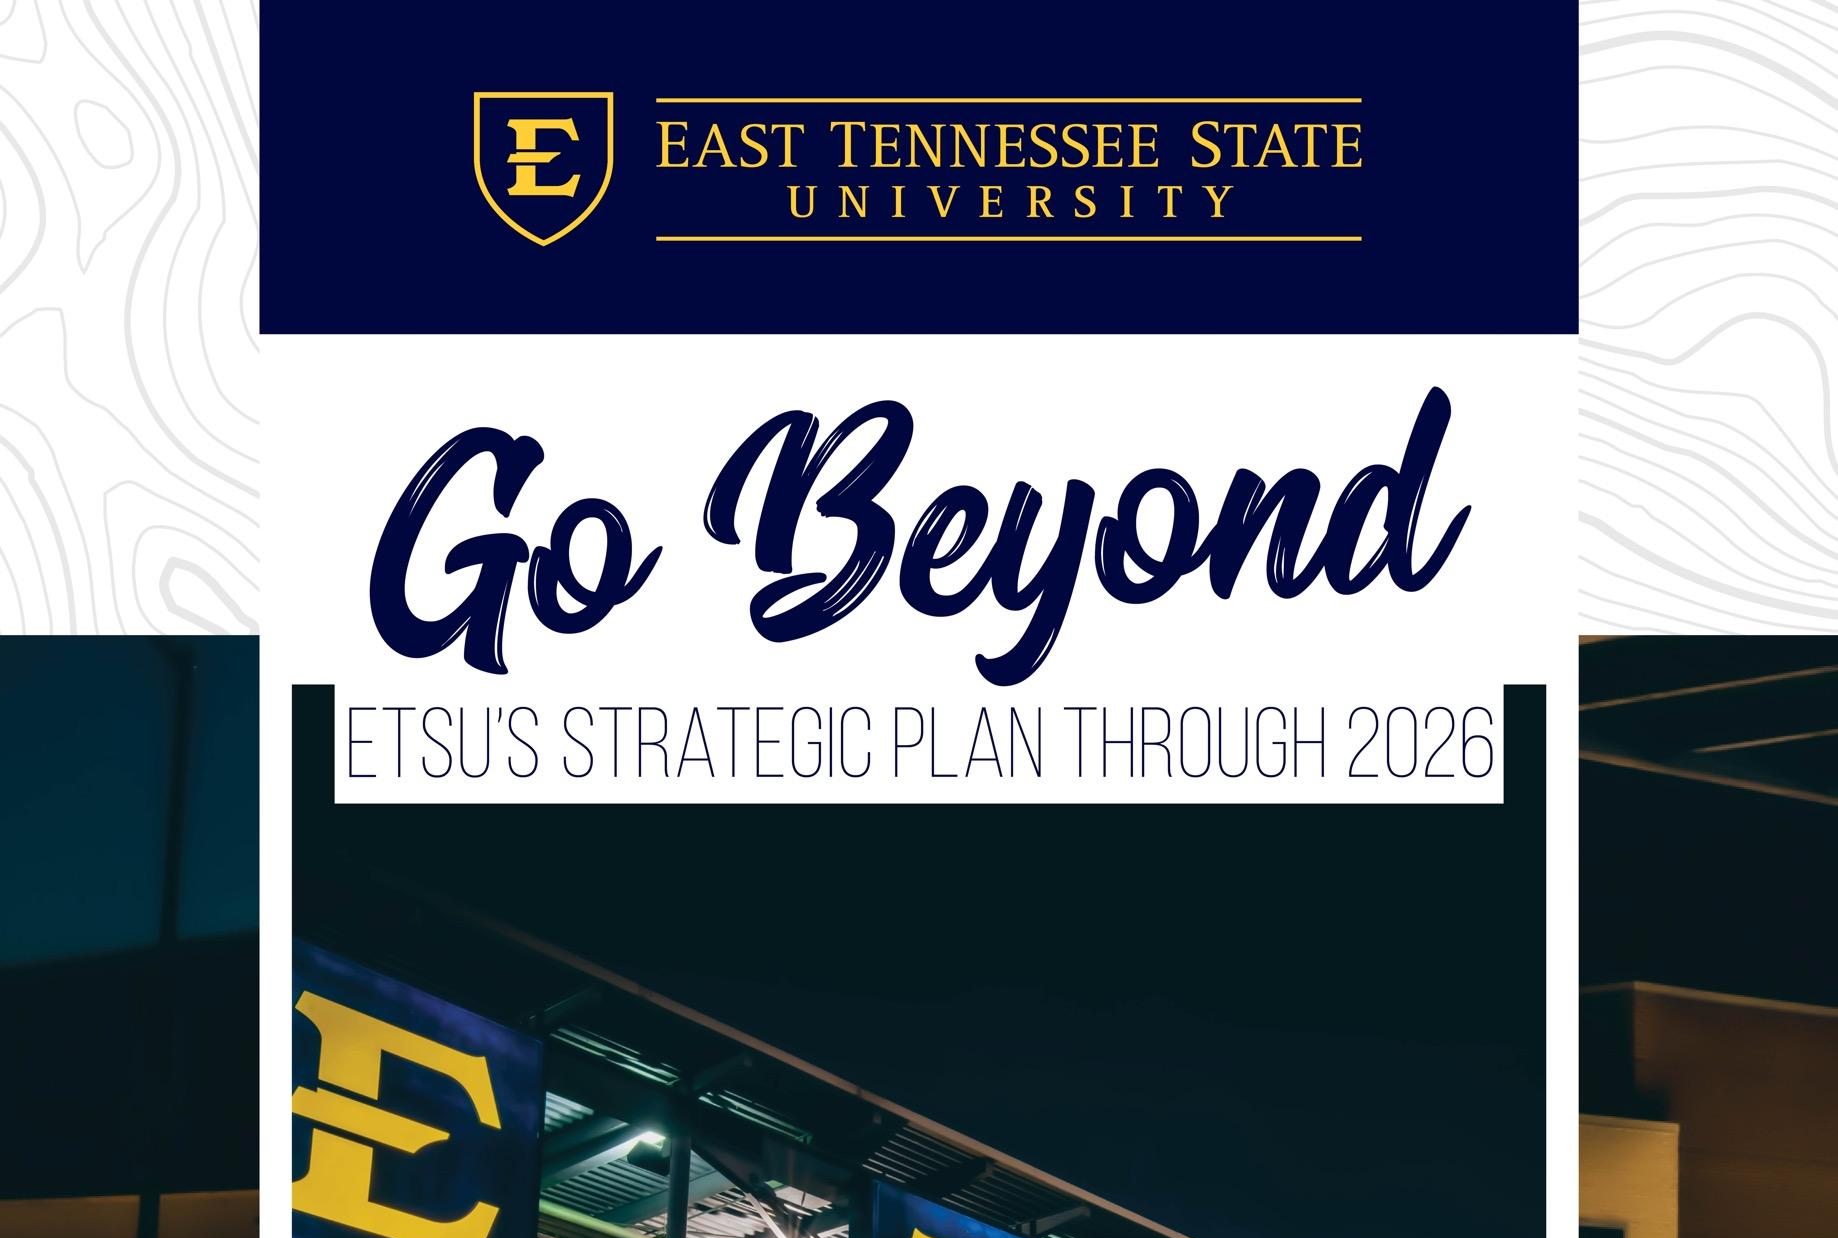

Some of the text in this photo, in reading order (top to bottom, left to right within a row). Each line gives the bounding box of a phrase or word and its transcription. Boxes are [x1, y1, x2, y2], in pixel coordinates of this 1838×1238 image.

[657, 121, 1362, 168] EAST TENNESSEE STATE
[788, 186, 1233, 218] UNIVERSITY
[370, 387, 1471, 687] Go Beyond
[349, 707, 1494, 779] ETSU'S STRATEGIC PLAN THROUGH 2026
